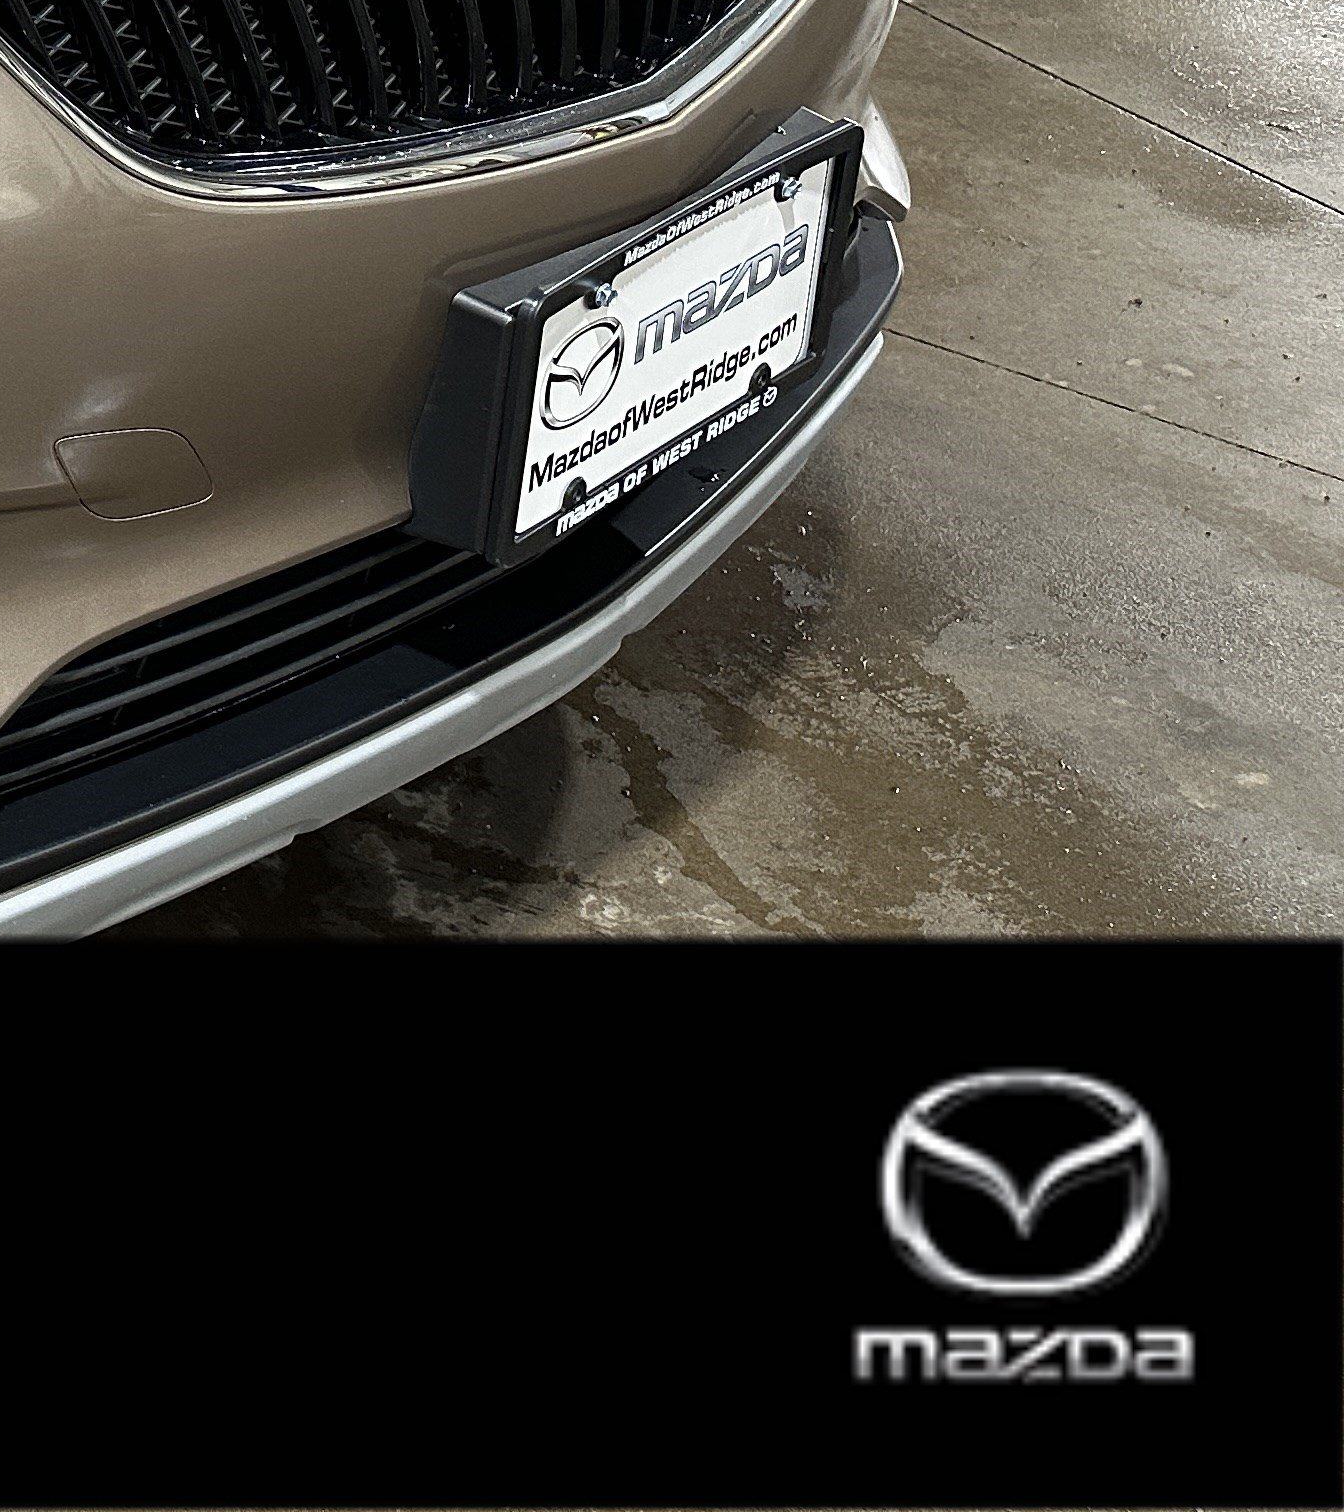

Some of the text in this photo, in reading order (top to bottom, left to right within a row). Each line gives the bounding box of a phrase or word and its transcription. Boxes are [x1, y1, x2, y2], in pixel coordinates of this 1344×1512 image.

[624, 172, 780, 267] MazdaOfWestRidge.com
[634, 223, 809, 365] mazda
[528, 312, 798, 493] MazdaofWestRidge.com
[555, 395, 762, 537] mazda OF WEST RIDGE
